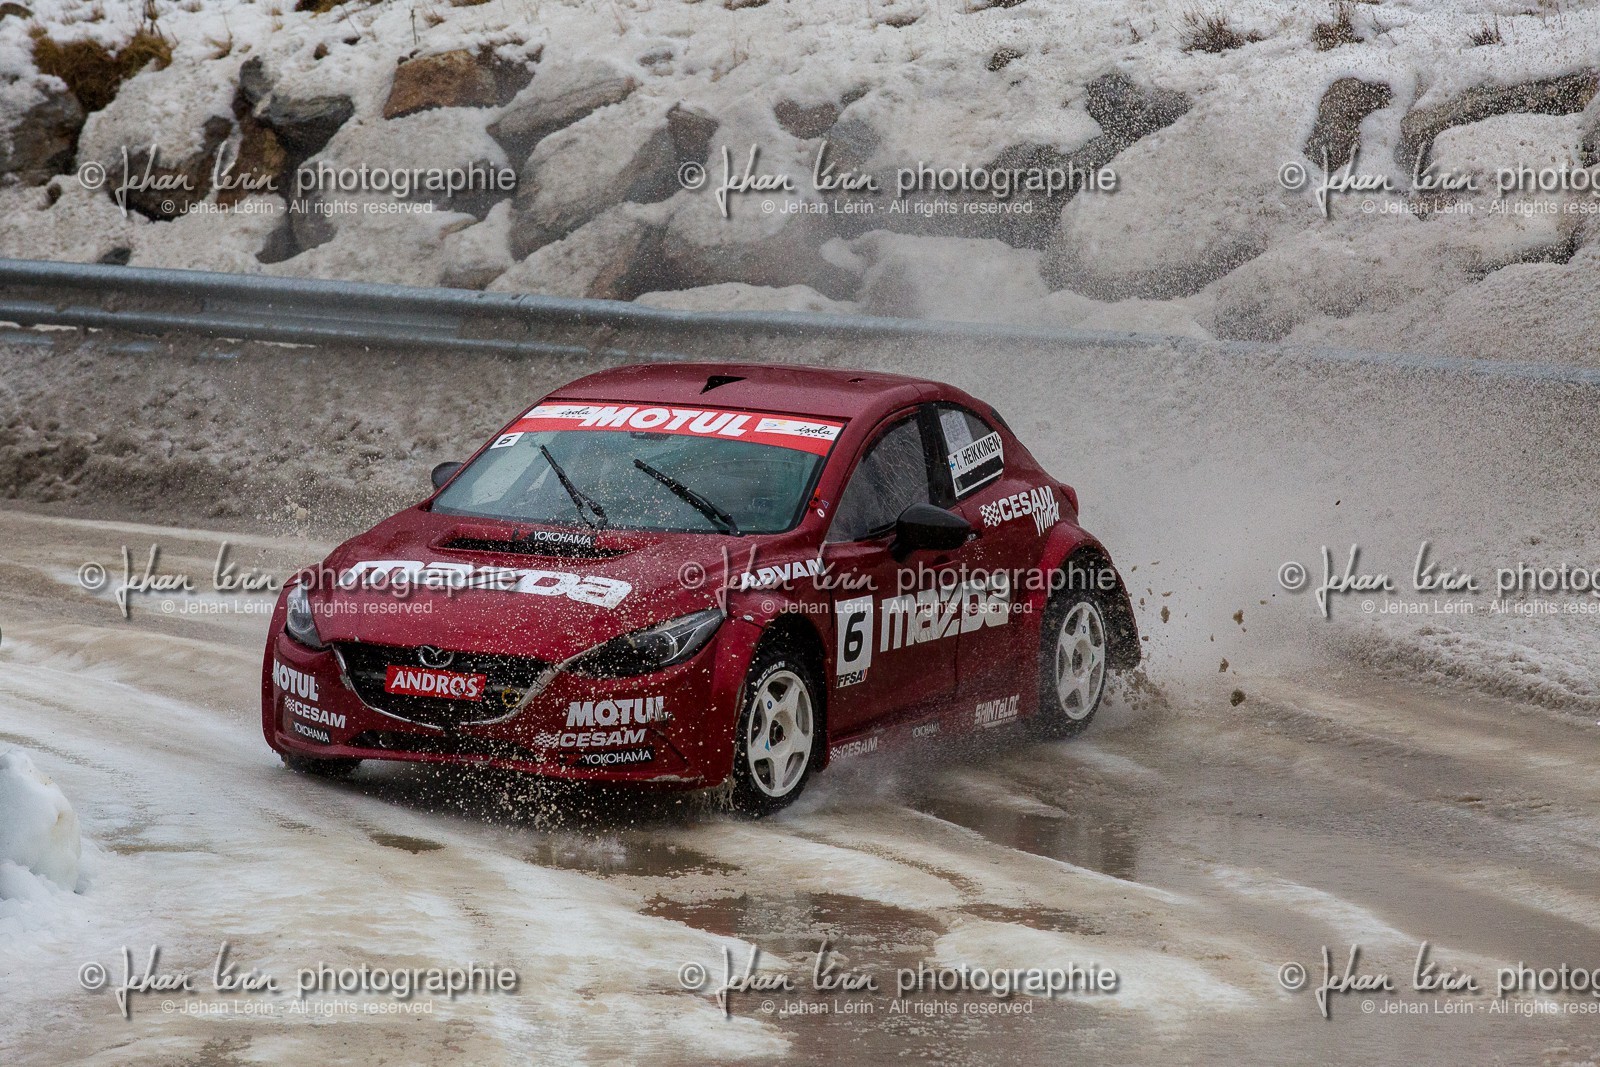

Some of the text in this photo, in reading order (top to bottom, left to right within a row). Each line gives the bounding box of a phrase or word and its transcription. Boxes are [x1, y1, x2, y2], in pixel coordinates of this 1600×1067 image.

[578, 406, 753, 437] MOTUL
[497, 434, 516, 447] 6
[961, 433, 1001, 467] HEIKKINEN
[998, 485, 1055, 521] CESAM
[534, 530, 592, 545] YOKOHAMA
[741, 557, 826, 588] ADVAN
[843, 610, 867, 663] 6
[272, 658, 319, 702] MOTUL
[391, 671, 478, 698] ANDROS
[837, 669, 864, 688] FFSA
[295, 701, 346, 729] CESAM
[566, 696, 668, 727] MOTUL
[293, 720, 330, 743] YOKOHAMA
[560, 728, 647, 748] CESAM
[584, 750, 652, 765] YOKOHAMA
[841, 737, 878, 759] CESAM
